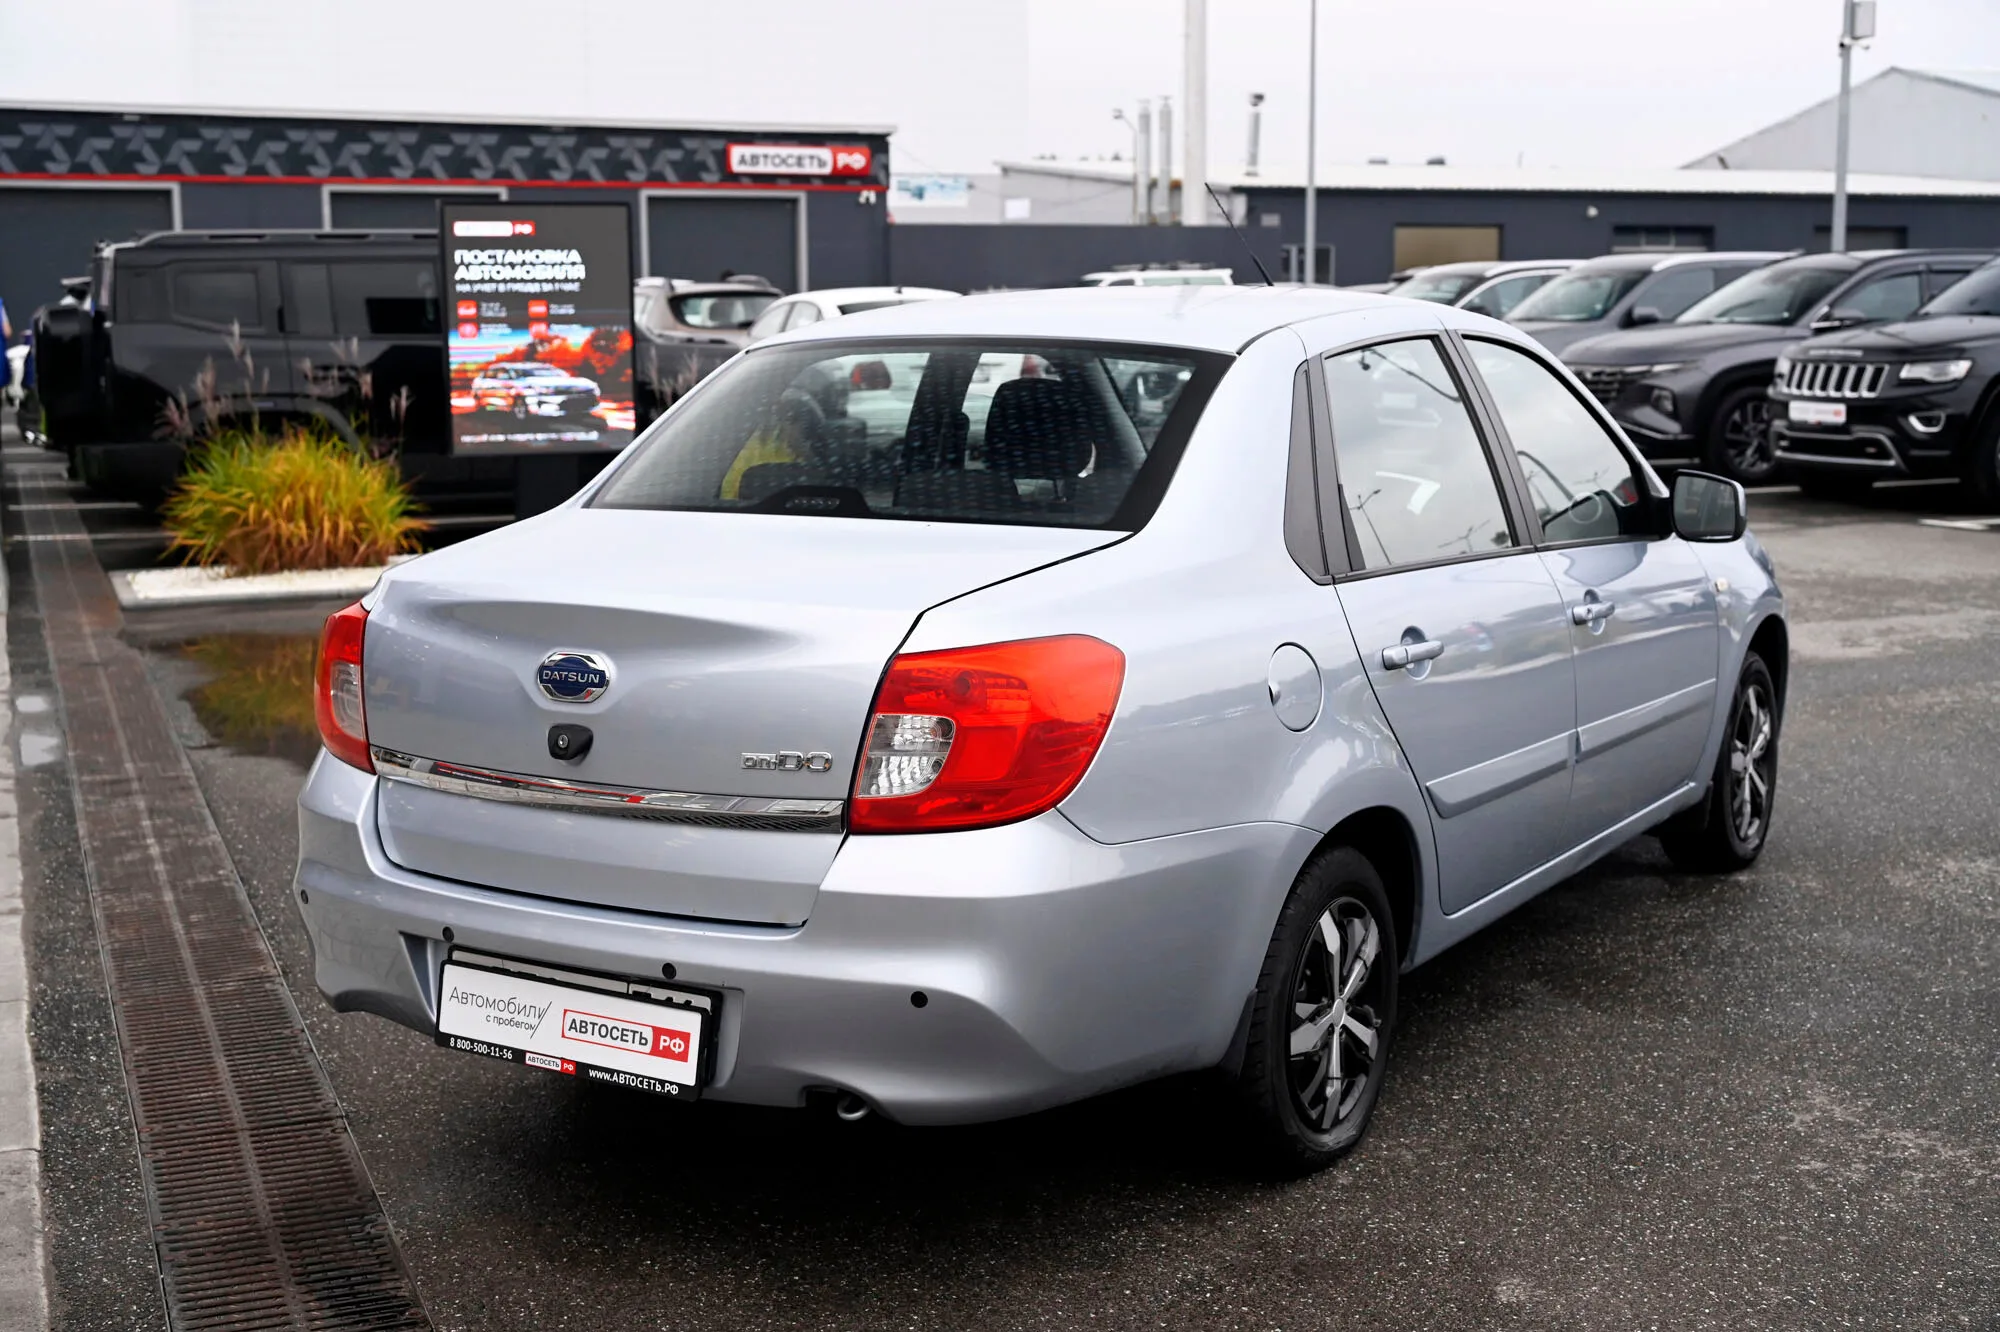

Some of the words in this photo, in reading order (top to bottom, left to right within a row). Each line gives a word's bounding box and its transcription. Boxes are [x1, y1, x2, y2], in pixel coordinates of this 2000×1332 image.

[737, 152, 828, 169] АВТОСЕТЬ
[836, 151, 867, 170] РФ
[454, 249, 582, 265] ПОСТАНОВКА
[454, 264, 586, 281] АВТОМОБИЛЯ
[542, 669, 600, 684] DATSUN
[485, 1014, 492, 1022] с
[493, 1015, 536, 1031] пробегом
[568, 1018, 649, 1046] АВТОСЕТЬ
[659, 1035, 685, 1054] РФ
[450, 1037, 455, 1047] 8
[456, 1038, 513, 1060] 800-500-11-56
[527, 1055, 560, 1069] АВТОСЕТЬ
[563, 1063, 574, 1071] РФ
[588, 1069, 679, 1095] www.АВТОСЕТЬ.РФ
